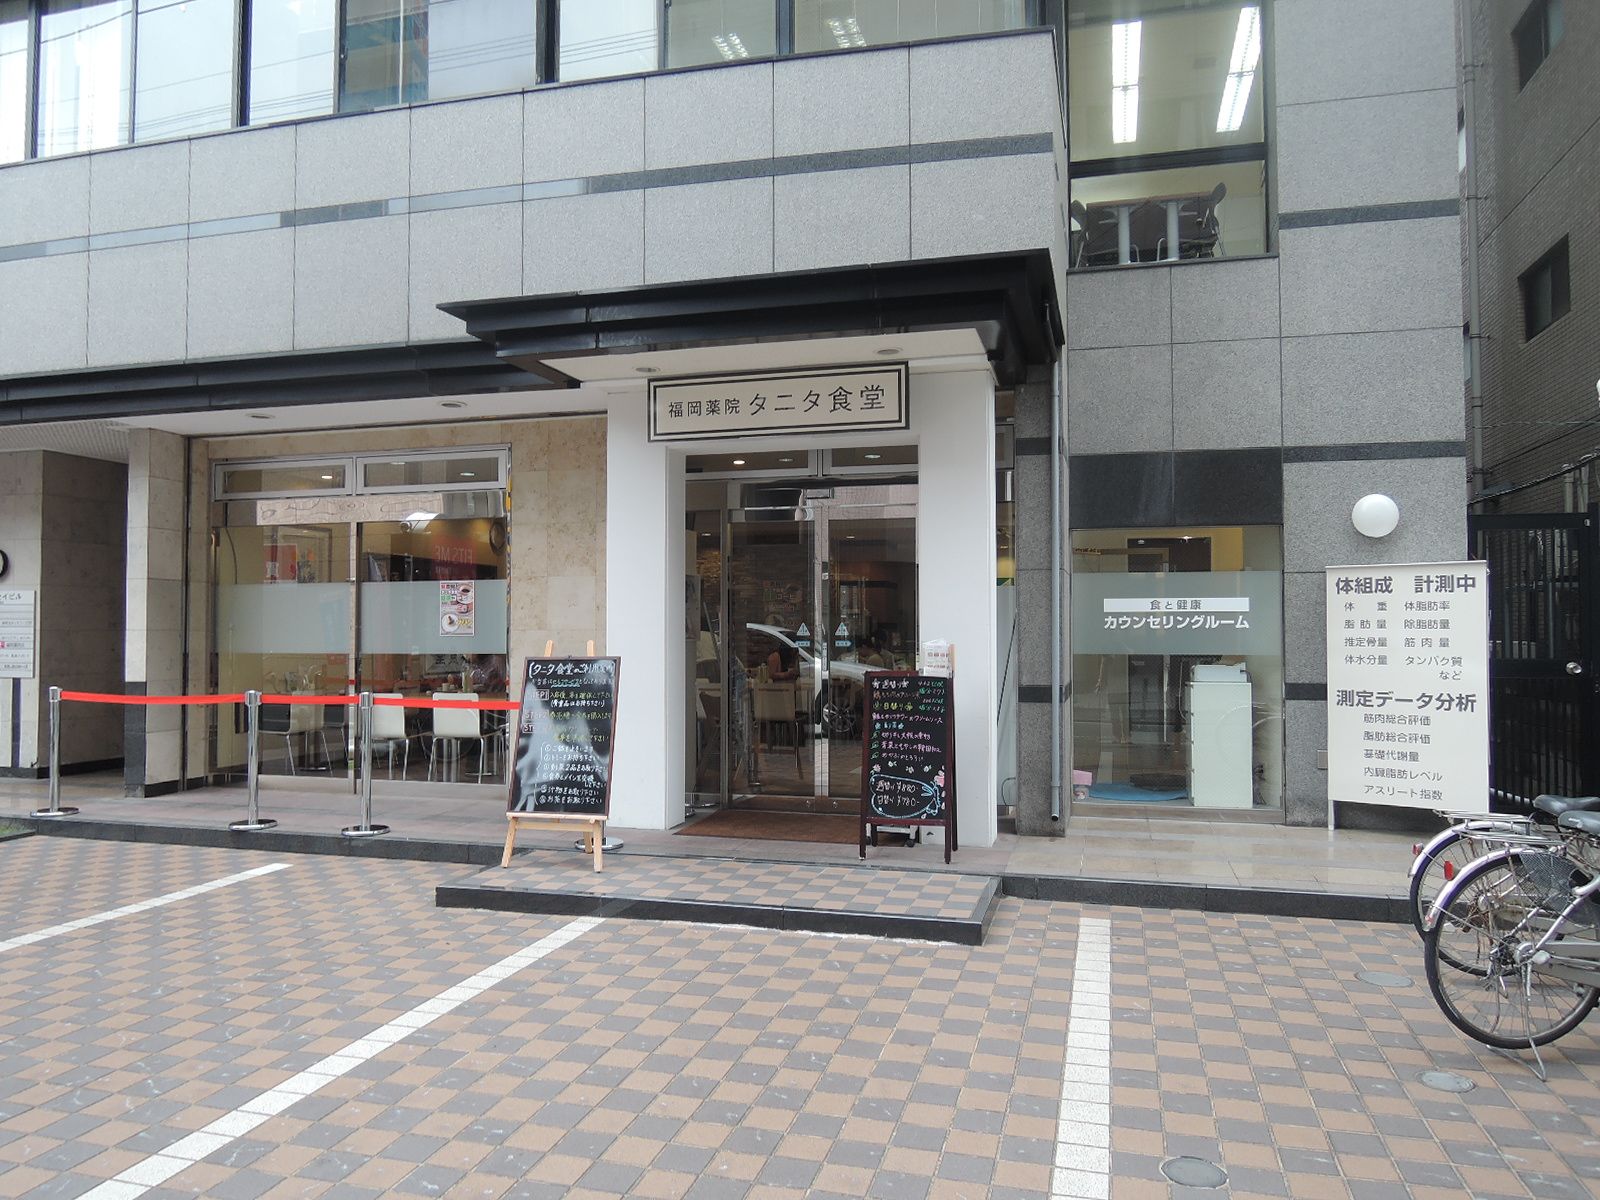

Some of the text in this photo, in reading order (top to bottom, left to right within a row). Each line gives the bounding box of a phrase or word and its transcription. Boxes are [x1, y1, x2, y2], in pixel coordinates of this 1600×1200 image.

[668, 384, 885, 418] 福岡薬院 タニタ食堂
[1335, 574, 1477, 595] 体組成 計測中
[1150, 599, 1202, 610] 食と健康
[1404, 601, 1450, 612] 体脂肪率
[1103, 615, 1250, 629] カウンセリングルーム
[1403, 618, 1450, 630] 除脂肪量
[1344, 637, 1388, 648] 推定骨量
[1344, 654, 1388, 666] 体水分量
[1439, 669, 1462, 681] など
[1336, 689, 1477, 713] 測定データ分析
[1363, 713, 1431, 726] 筋肉総合評価
[1363, 730, 1431, 745] 脂肪総合評価
[1363, 748, 1419, 762] 基礎代謝量
[1364, 766, 1443, 782] 内臓脂肪レベル
[1364, 785, 1443, 801] アスリート指数
